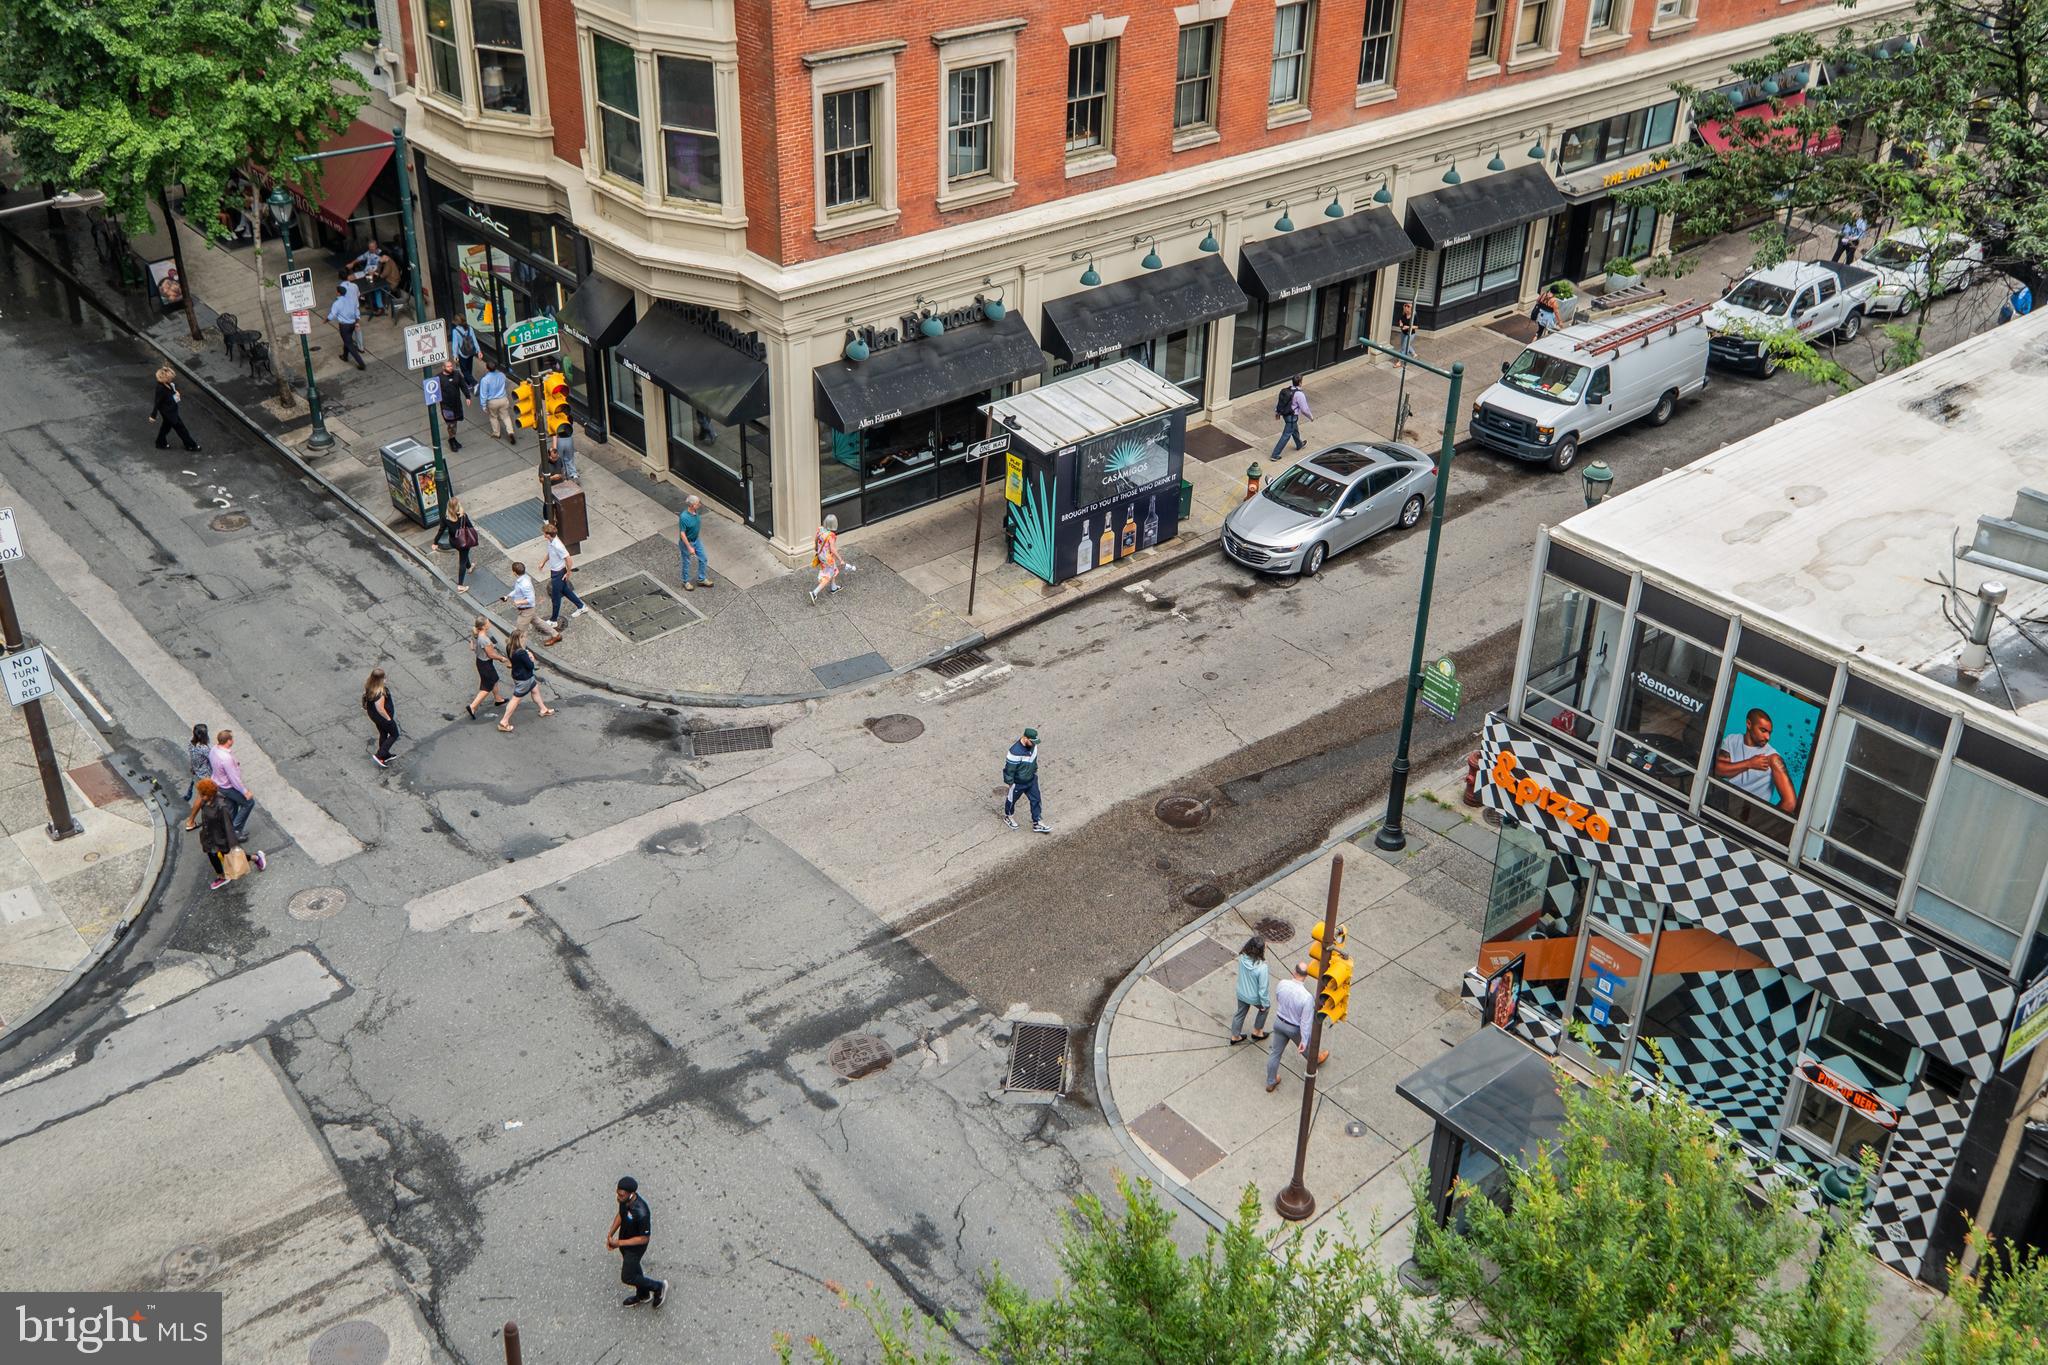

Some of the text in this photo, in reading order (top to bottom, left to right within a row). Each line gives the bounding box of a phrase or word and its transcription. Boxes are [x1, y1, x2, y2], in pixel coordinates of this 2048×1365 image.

[1602, 171, 1623, 188] THE
[424, 321, 443, 333] BLOCK
[518, 327, 541, 343] 18TH
[546, 326, 557, 335] ST
[524, 341, 553, 354] ONE WAY
[1084, 350, 1098, 360] Allen
[1099, 341, 1122, 355] Edmonds
[411, 352, 446, 366] THE BOX
[858, 409, 902, 429] Allen Edmonds
[992, 440, 1005, 449] WAY
[1102, 462, 1148, 485] CASAMIGOS
[1061, 506, 1089, 522] BROUGHT
[1090, 503, 1099, 511] TO
[1099, 498, 1111, 508] YOU
[1112, 495, 1120, 503] BY
[1120, 489, 1138, 500] THOSE
[1139, 483, 1154, 494] WHO
[1154, 476, 1171, 487] DRINK
[12, 656, 32, 669] NO
[12, 666, 39, 680] TURN
[22, 678, 36, 688] ON
[1637, 671, 1704, 712] Removery
[21, 687, 41, 698] RED
[1492, 750, 1609, 843] &pizza
[1853, 1092, 1878, 1114] HERE
